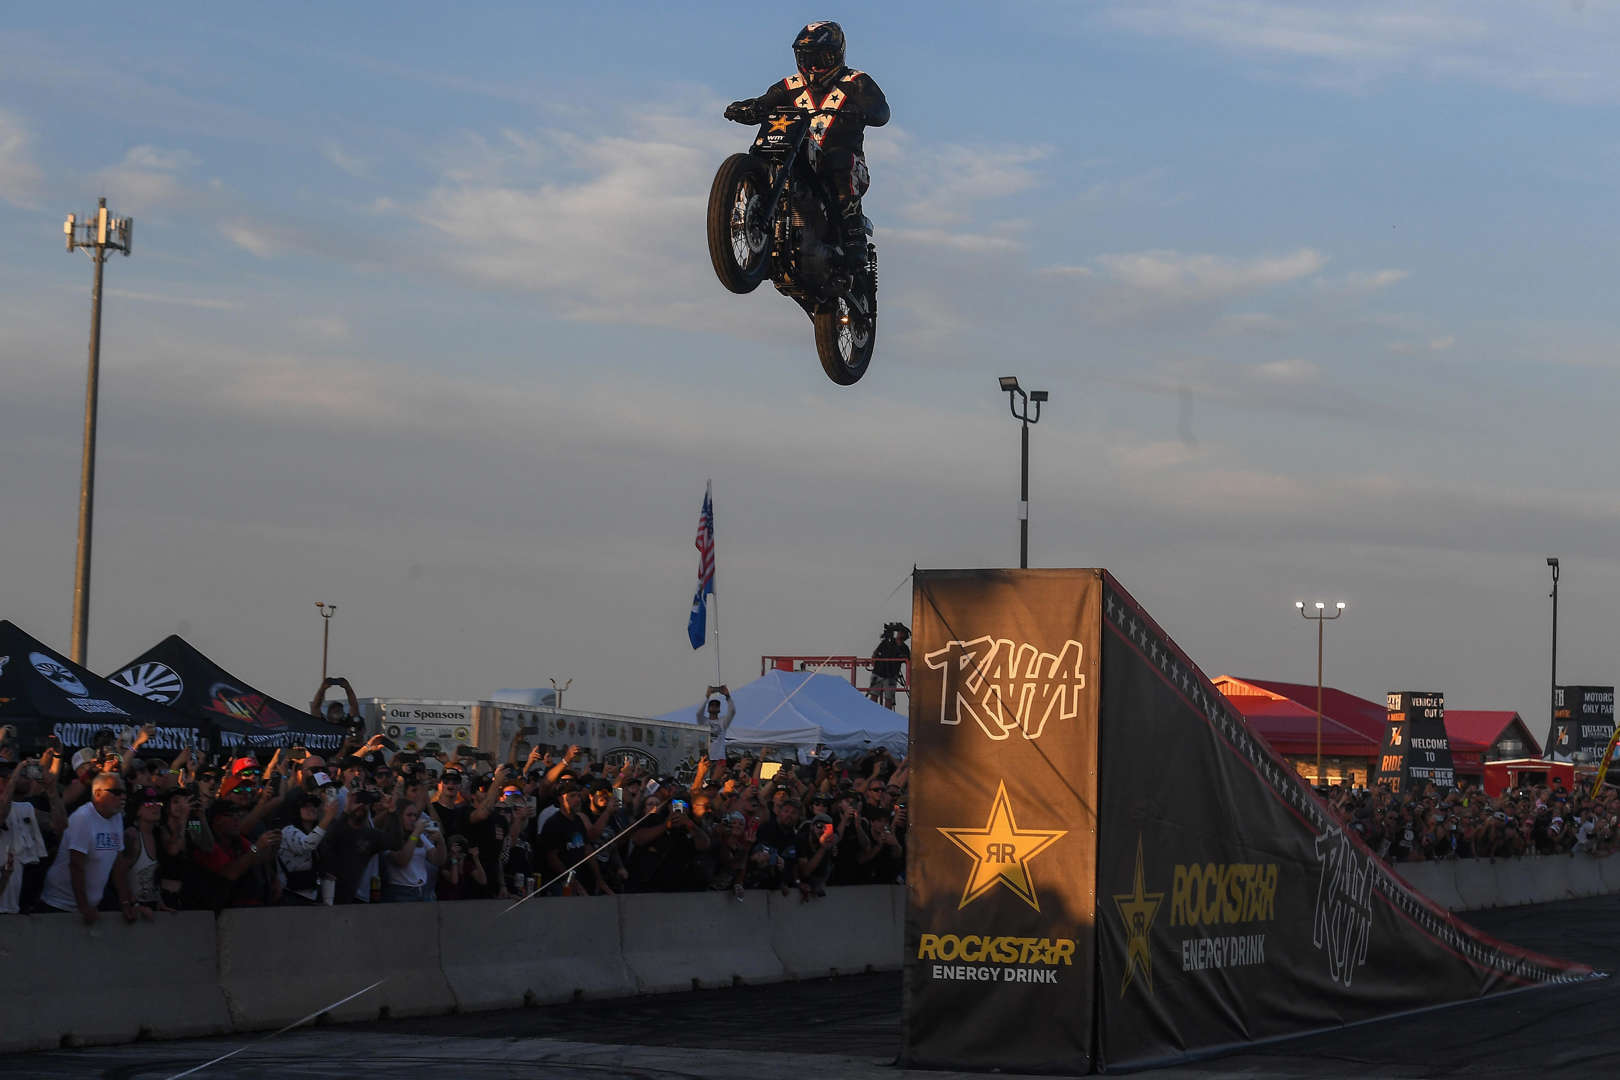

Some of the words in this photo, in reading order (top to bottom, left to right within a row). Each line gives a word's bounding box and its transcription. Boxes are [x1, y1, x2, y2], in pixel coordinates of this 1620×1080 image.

[391, 709, 410, 718] Our
[415, 709, 465, 720] Sponsors
[1424, 708, 1438, 718] OUT
[1583, 704, 1599, 714] ONLY
[1410, 738, 1448, 750] WELCOME
[1381, 755, 1404, 772] RIDE
[1425, 752, 1436, 762] TO
[1170, 863, 1278, 927] ROCKSTAR
[918, 933, 1077, 966] ROCKSTAR
[1182, 937, 1230, 972] ENERGY
[1231, 934, 1265, 967] DRINK
[932, 965, 1001, 981] ENERGY
[1004, 967, 1058, 984] DRINK
